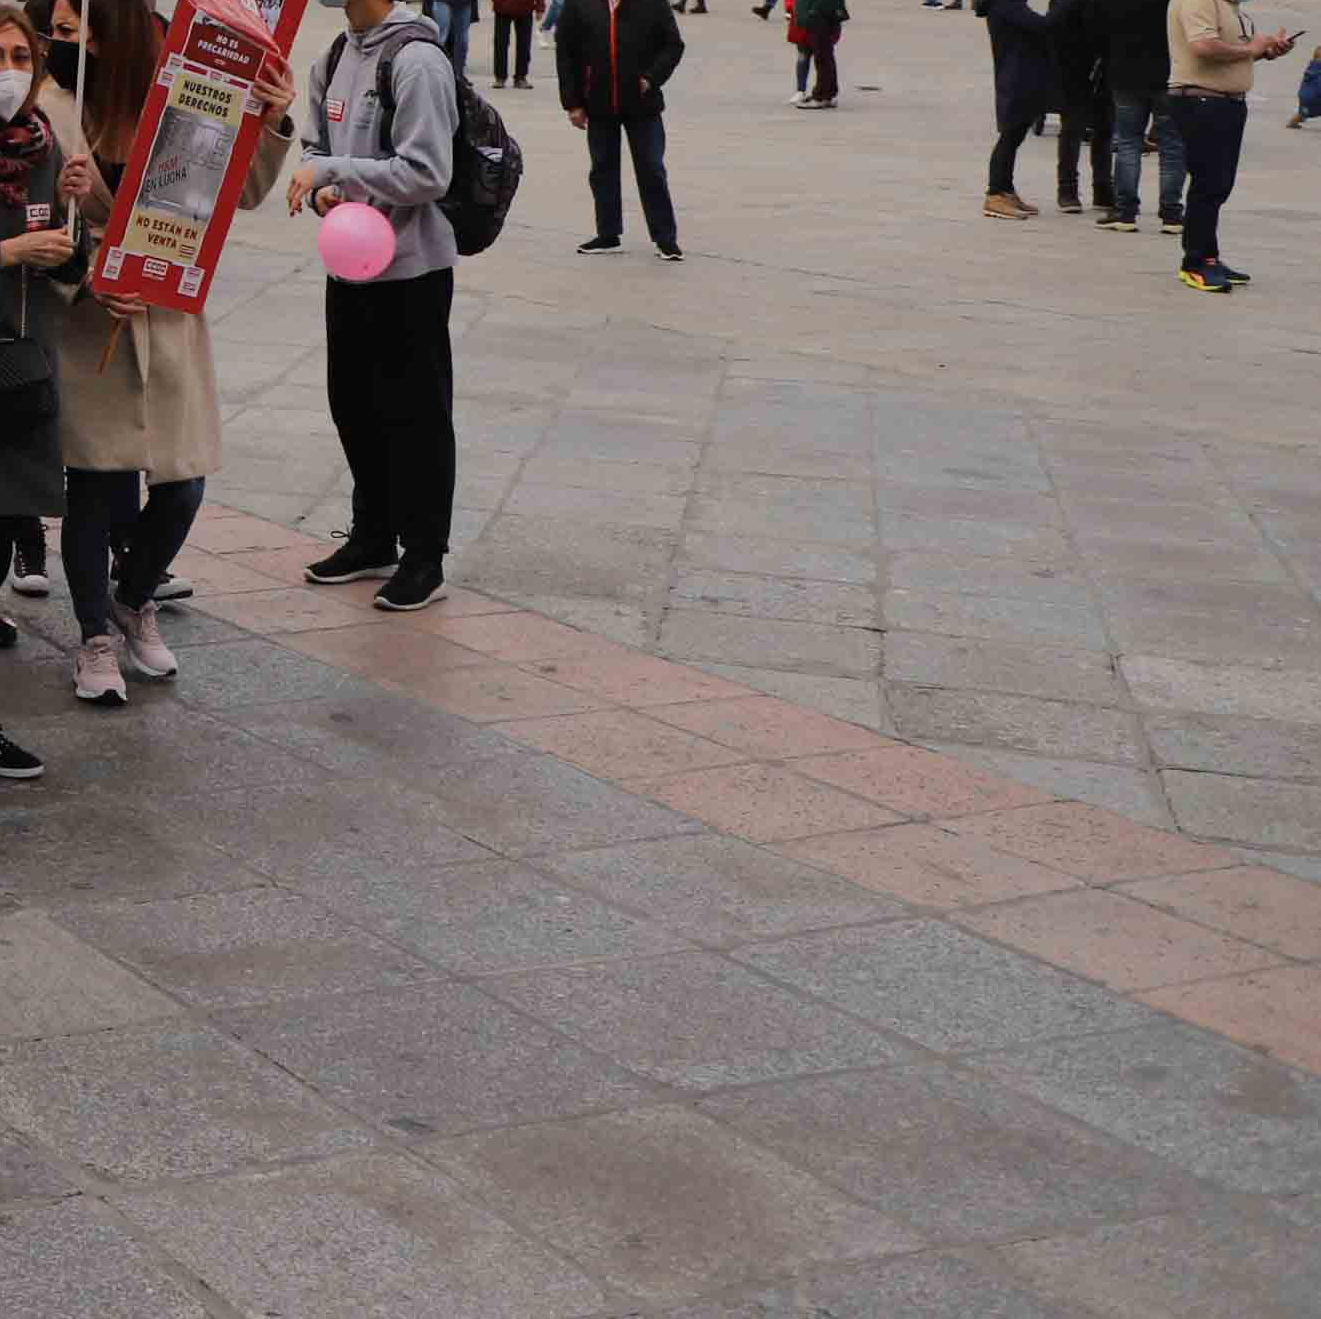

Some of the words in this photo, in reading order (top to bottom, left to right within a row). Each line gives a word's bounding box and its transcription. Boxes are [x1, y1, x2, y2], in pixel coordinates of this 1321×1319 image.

[197, 39, 251, 65] PRECARIEDAD
[215, 33, 228, 45] NO
[228, 38, 239, 49] ES
[183, 79, 233, 104] NUESTROS
[178, 93, 229, 118] DERECHOS
[157, 167, 187, 188] LUCHA
[136, 214, 151, 228] NO
[185, 228, 199, 241] EN
[147, 232, 178, 249] VENTA
